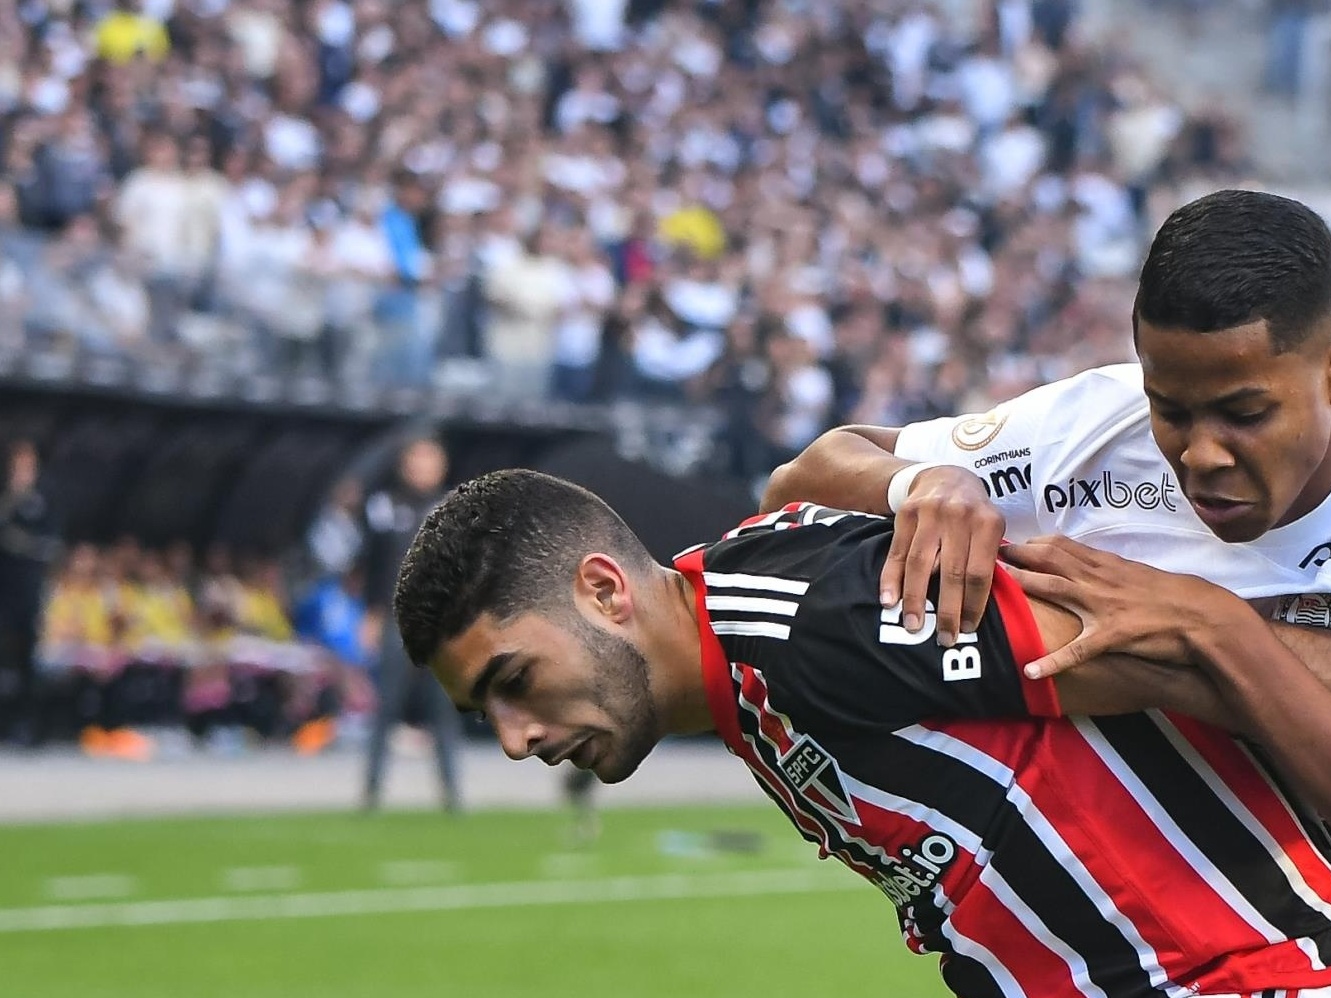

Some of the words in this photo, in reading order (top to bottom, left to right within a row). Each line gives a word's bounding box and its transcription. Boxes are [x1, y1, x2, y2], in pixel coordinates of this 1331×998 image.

[974, 447, 1031, 469] CORINTHIANS
[1043, 470, 1177, 513] pixbet
[786, 746, 822, 785] SPFC
